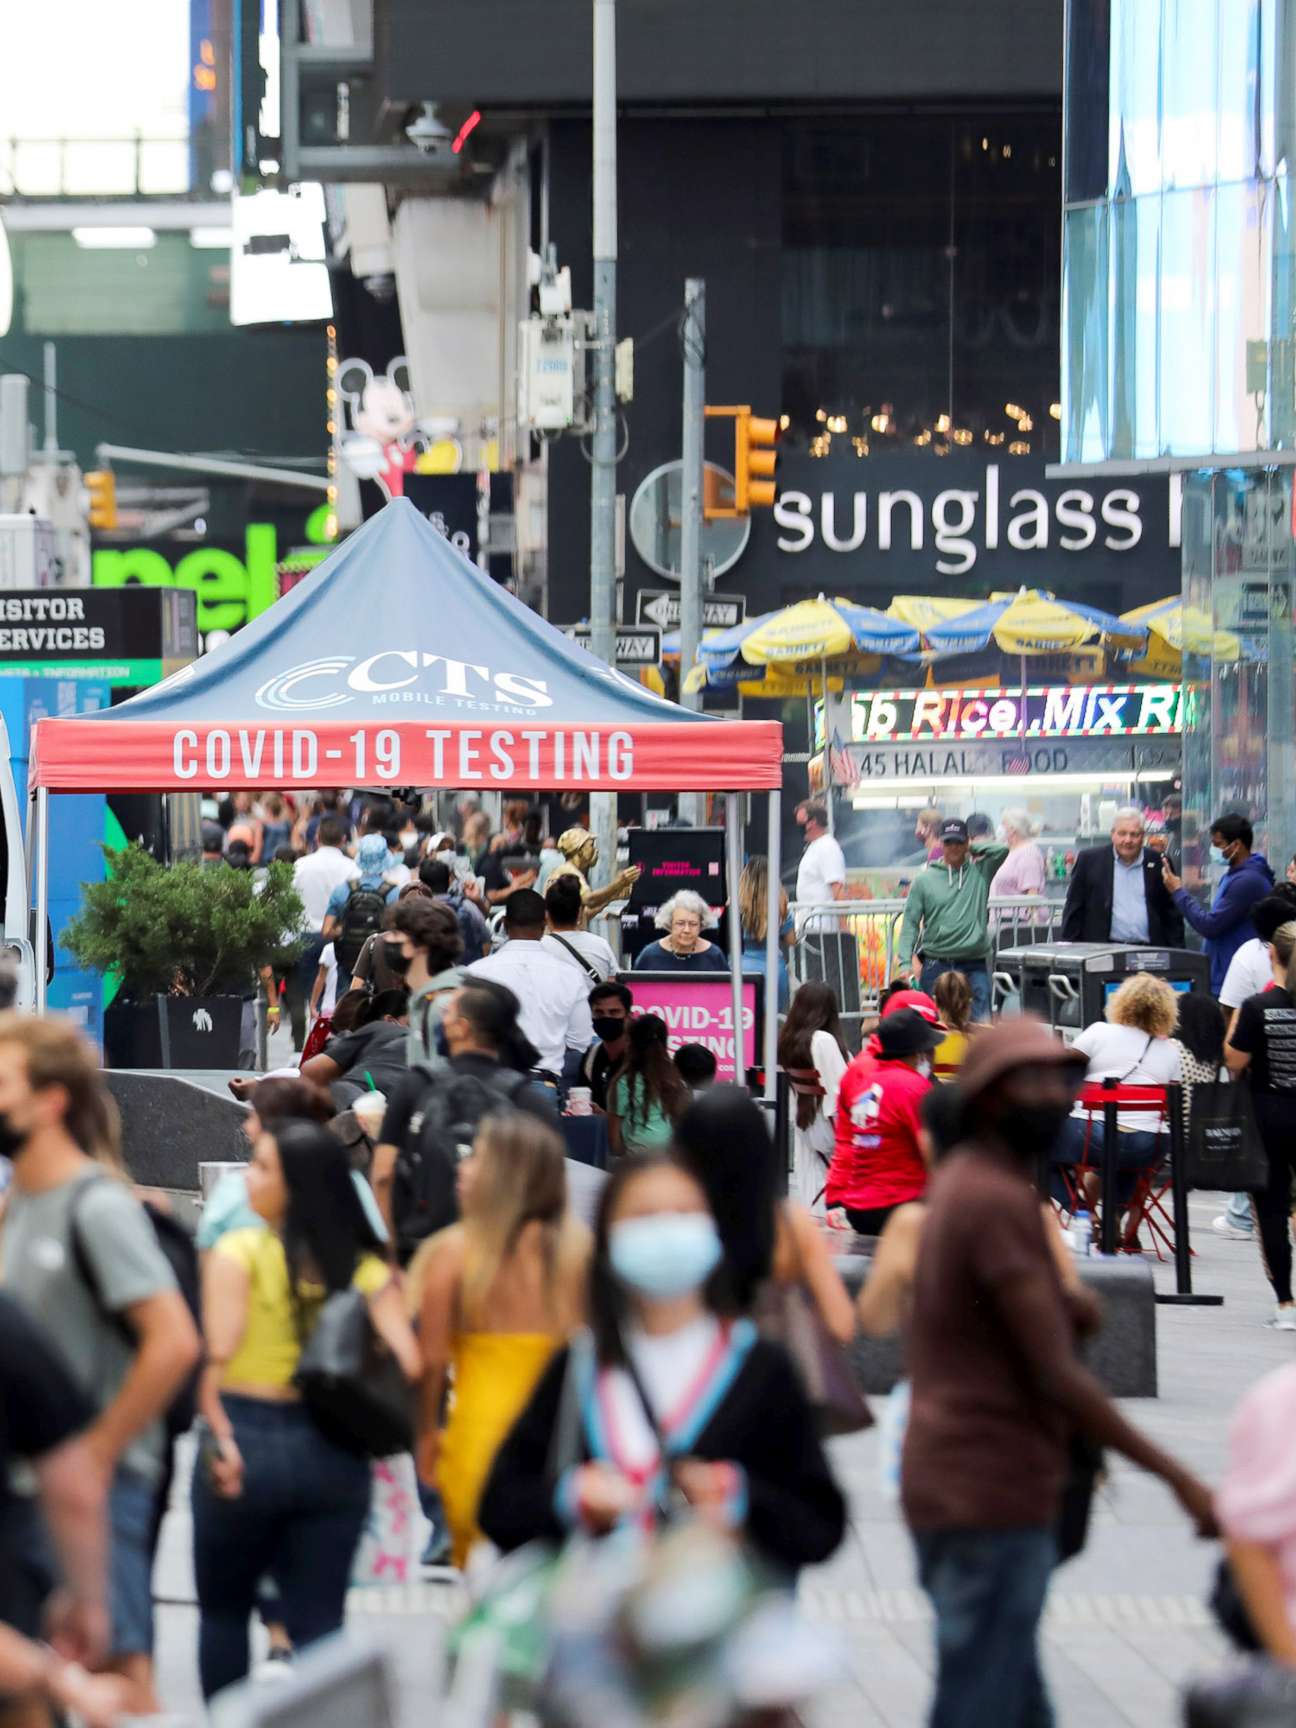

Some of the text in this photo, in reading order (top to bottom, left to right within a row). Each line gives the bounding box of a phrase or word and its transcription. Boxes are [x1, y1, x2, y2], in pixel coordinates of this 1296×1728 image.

[775, 464, 1142, 576] sunglass
[616, 637, 650, 657] WAY
[347, 650, 554, 708] CTS
[372, 692, 537, 717] MOBILE TESTING
[172, 728, 636, 781] COVID-19 TESTING
[860, 753, 886, 776] 45
[894, 750, 969, 776] HALAL
